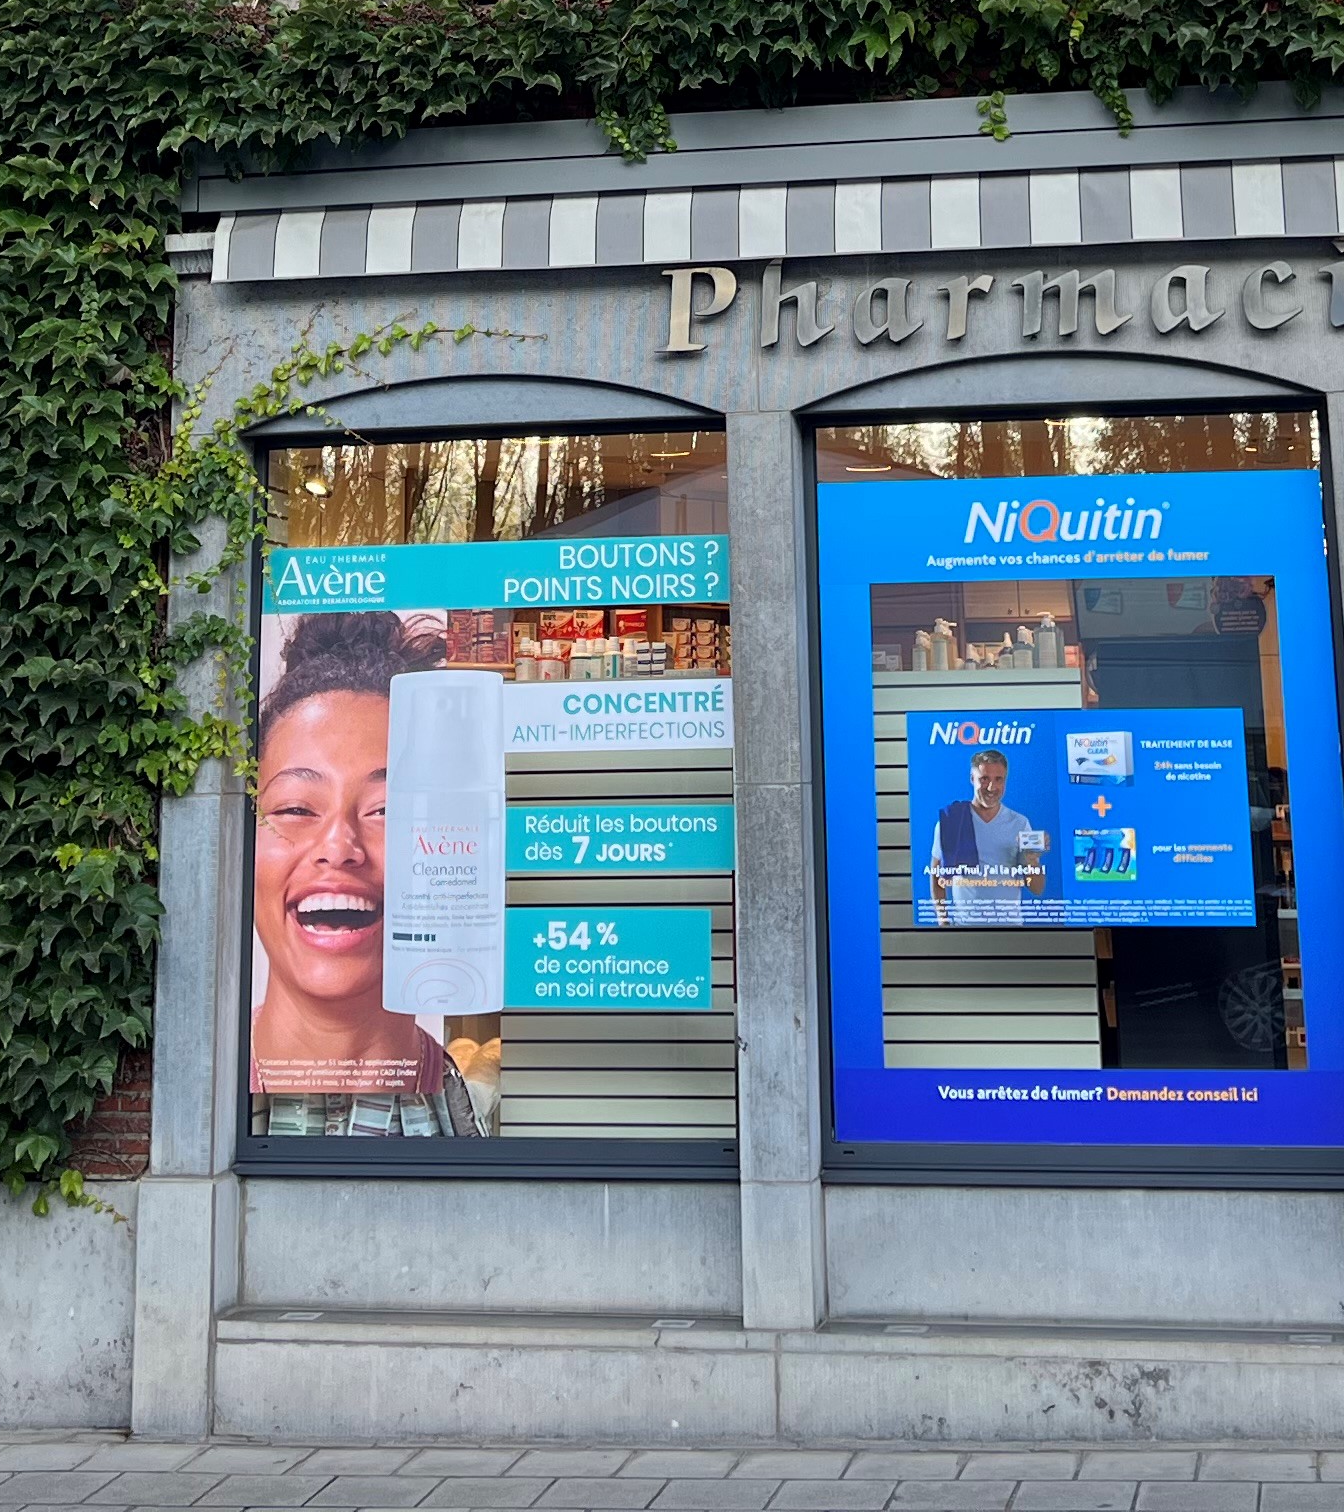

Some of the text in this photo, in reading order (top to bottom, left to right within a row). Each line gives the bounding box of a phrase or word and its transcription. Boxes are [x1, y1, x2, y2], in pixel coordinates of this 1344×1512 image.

[305, 553, 387, 565] EAU THERMALE
[559, 540, 720, 570] BOUTONS ?
[925, 554, 997, 570] Augmente
[999, 556, 1023, 566] vos
[1026, 552, 1081, 565] chances
[1147, 549, 1165, 562] de
[1167, 548, 1210, 562] fumer
[275, 556, 386, 597] Avène
[503, 571, 720, 603] POINTS NOIRS ?
[562, 684, 725, 716] CONCENTRÉ
[511, 720, 725, 743] ANTI-IMPERFECTIONS
[1140, 739, 1233, 749] TRAITEMENT DE BASE
[1194, 761, 1222, 770] besoin
[1177, 771, 1212, 781] nicotine
[524, 813, 718, 834] Réduit les boutons
[413, 834, 479, 856] Avène
[524, 841, 563, 861] dès
[571, 835, 591, 865] 7
[1152, 844, 1173, 854] pour
[412, 862, 478, 877] Cleanance
[923, 864, 982, 877] Aujourd'hui,
[982, 865, 999, 877] j'ai
[1000, 865, 1010, 875] la
[1011, 865, 1040, 877] pêche
[532, 921, 619, 951] +54 %
[534, 955, 670, 975] de confiance
[535, 981, 561, 997] en
[565, 978, 594, 997] soi
[937, 1085, 1259, 1102] Vous arrêtez de fumer? Demandez conseil ici
